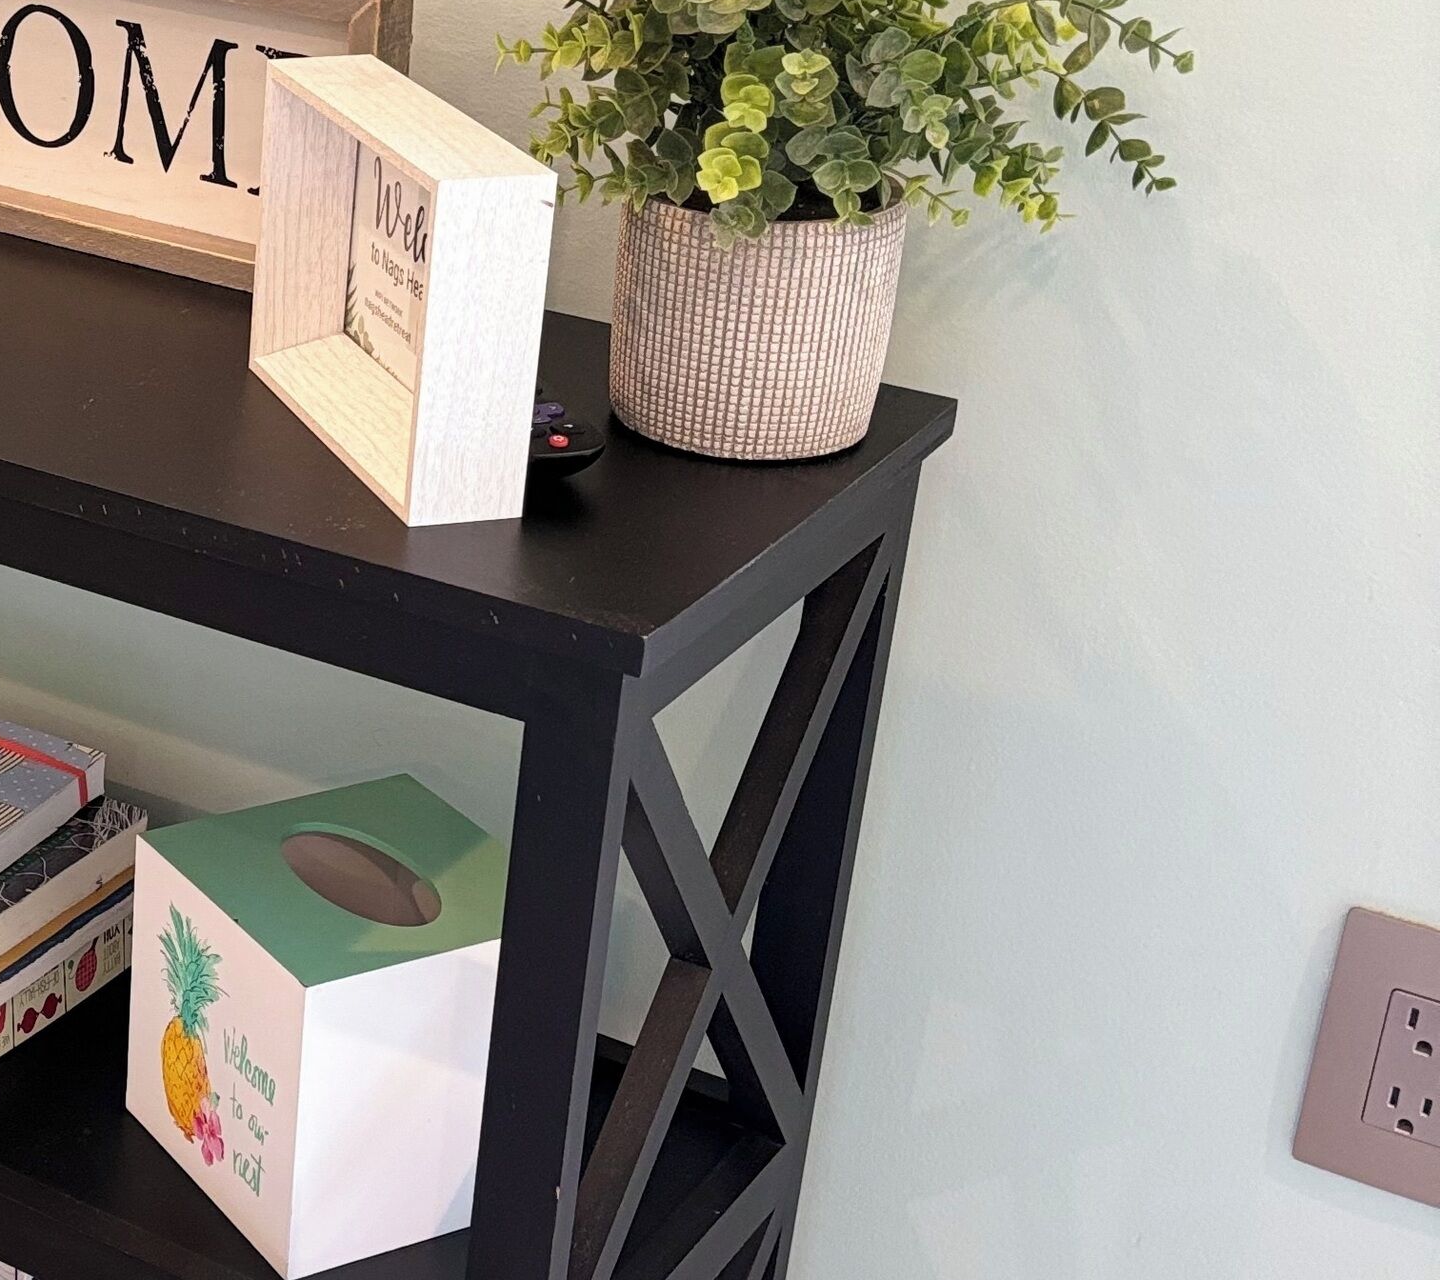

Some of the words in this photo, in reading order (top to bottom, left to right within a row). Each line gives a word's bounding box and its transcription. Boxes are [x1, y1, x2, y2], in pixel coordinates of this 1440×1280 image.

[370, 241, 380, 266] to
[381, 248, 404, 287] Nags
[406, 265, 423, 301] Hea
[223, 1026, 276, 1106] Welcome
[229, 1082, 243, 1120] to
[248, 1113, 269, 1146] our
[233, 1149, 266, 1197] nest
